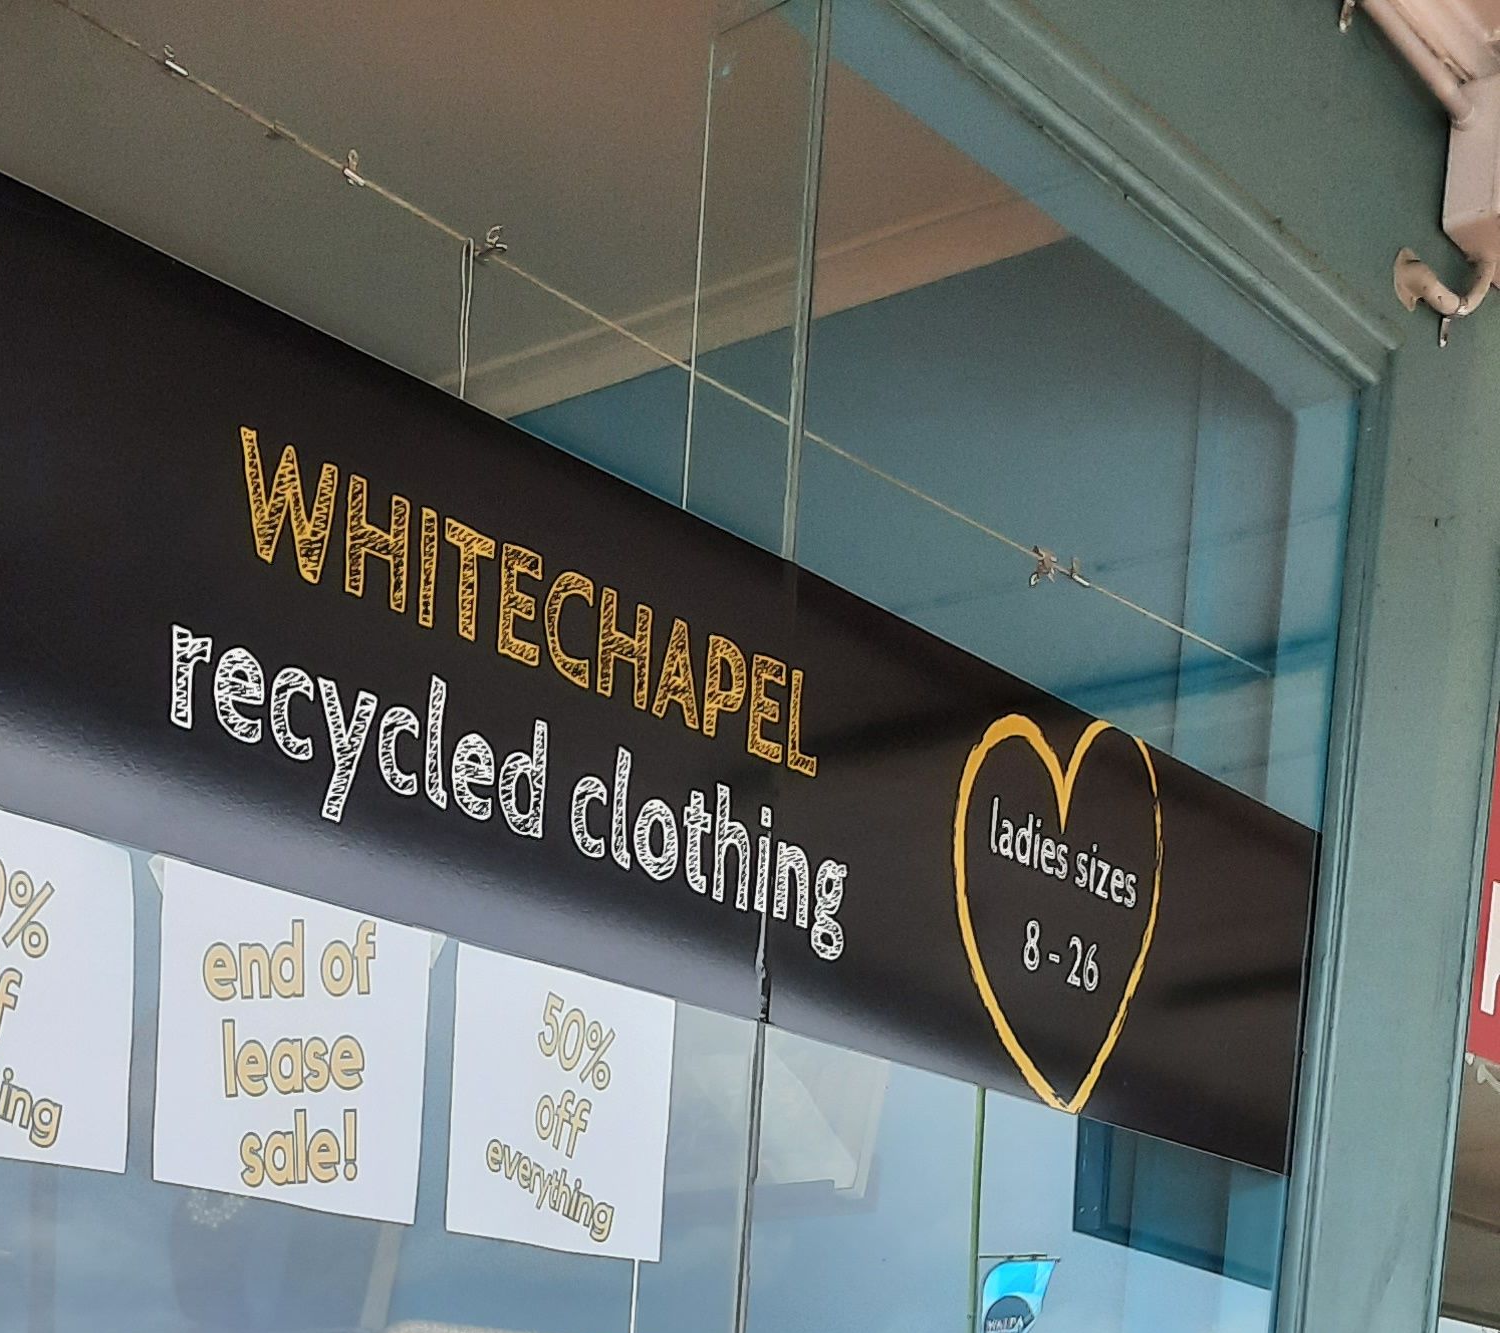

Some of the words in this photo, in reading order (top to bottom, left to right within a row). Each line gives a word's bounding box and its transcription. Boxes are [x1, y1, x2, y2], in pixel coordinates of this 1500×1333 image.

[239, 426, 818, 777] WHITECHAPEL
[171, 623, 550, 839] recycled
[570, 745, 848, 961] clothing
[989, 795, 1069, 880] ladies
[1074, 842, 1138, 908] sizes
[202, 918, 307, 1002] end
[320, 918, 378, 997] of
[1023, 919, 1041, 971] 8
[1065, 935, 1100, 992] 26
[221, 1018, 366, 1098] lease
[536, 991, 618, 1094] 50%
[239, 1108, 360, 1189] sale!
[534, 1089, 593, 1161] off
[484, 1136, 615, 1244] everything
